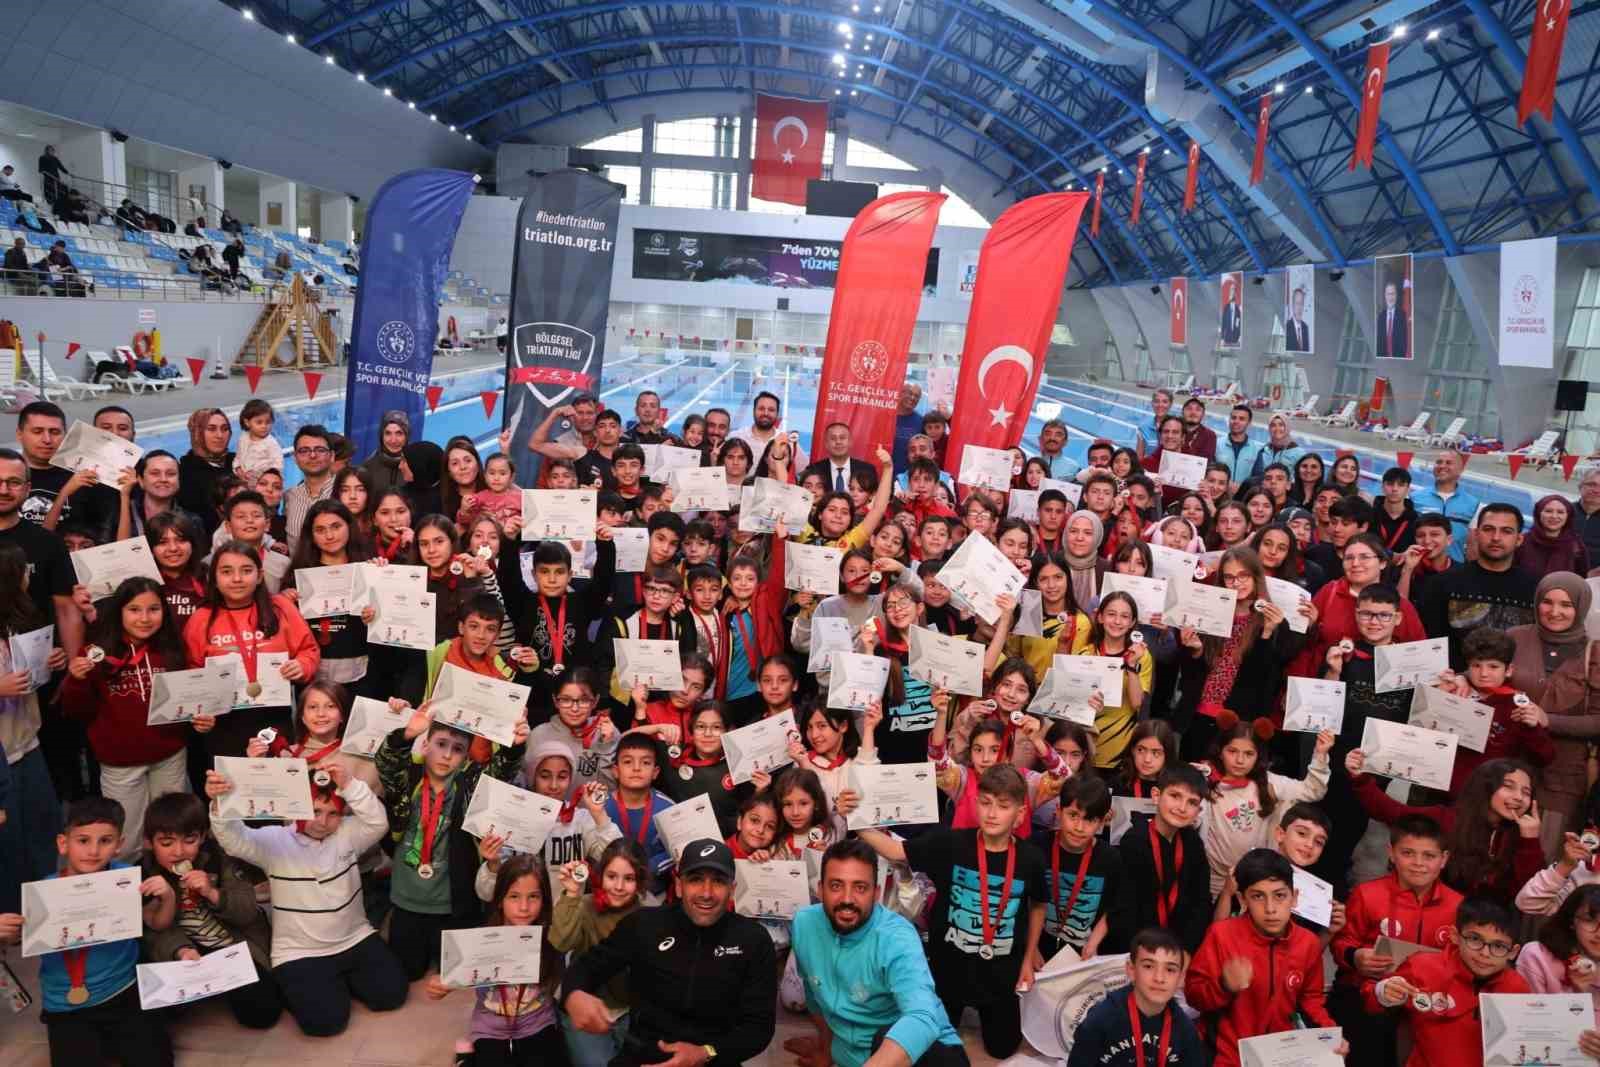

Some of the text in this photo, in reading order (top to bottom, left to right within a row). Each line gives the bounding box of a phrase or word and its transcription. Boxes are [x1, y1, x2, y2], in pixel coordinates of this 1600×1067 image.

[535, 210, 606, 230] #hedeftriatlon
[524, 227, 613, 252] triatlon.org.tr
[781, 243, 812, 256] 7'den
[799, 257, 839, 271] YÜZME
[535, 331, 574, 346] BÖLGESEL
[357, 361, 373, 372] T.C.
[355, 373, 379, 385] SPOR
[828, 393, 850, 404] SPOR
